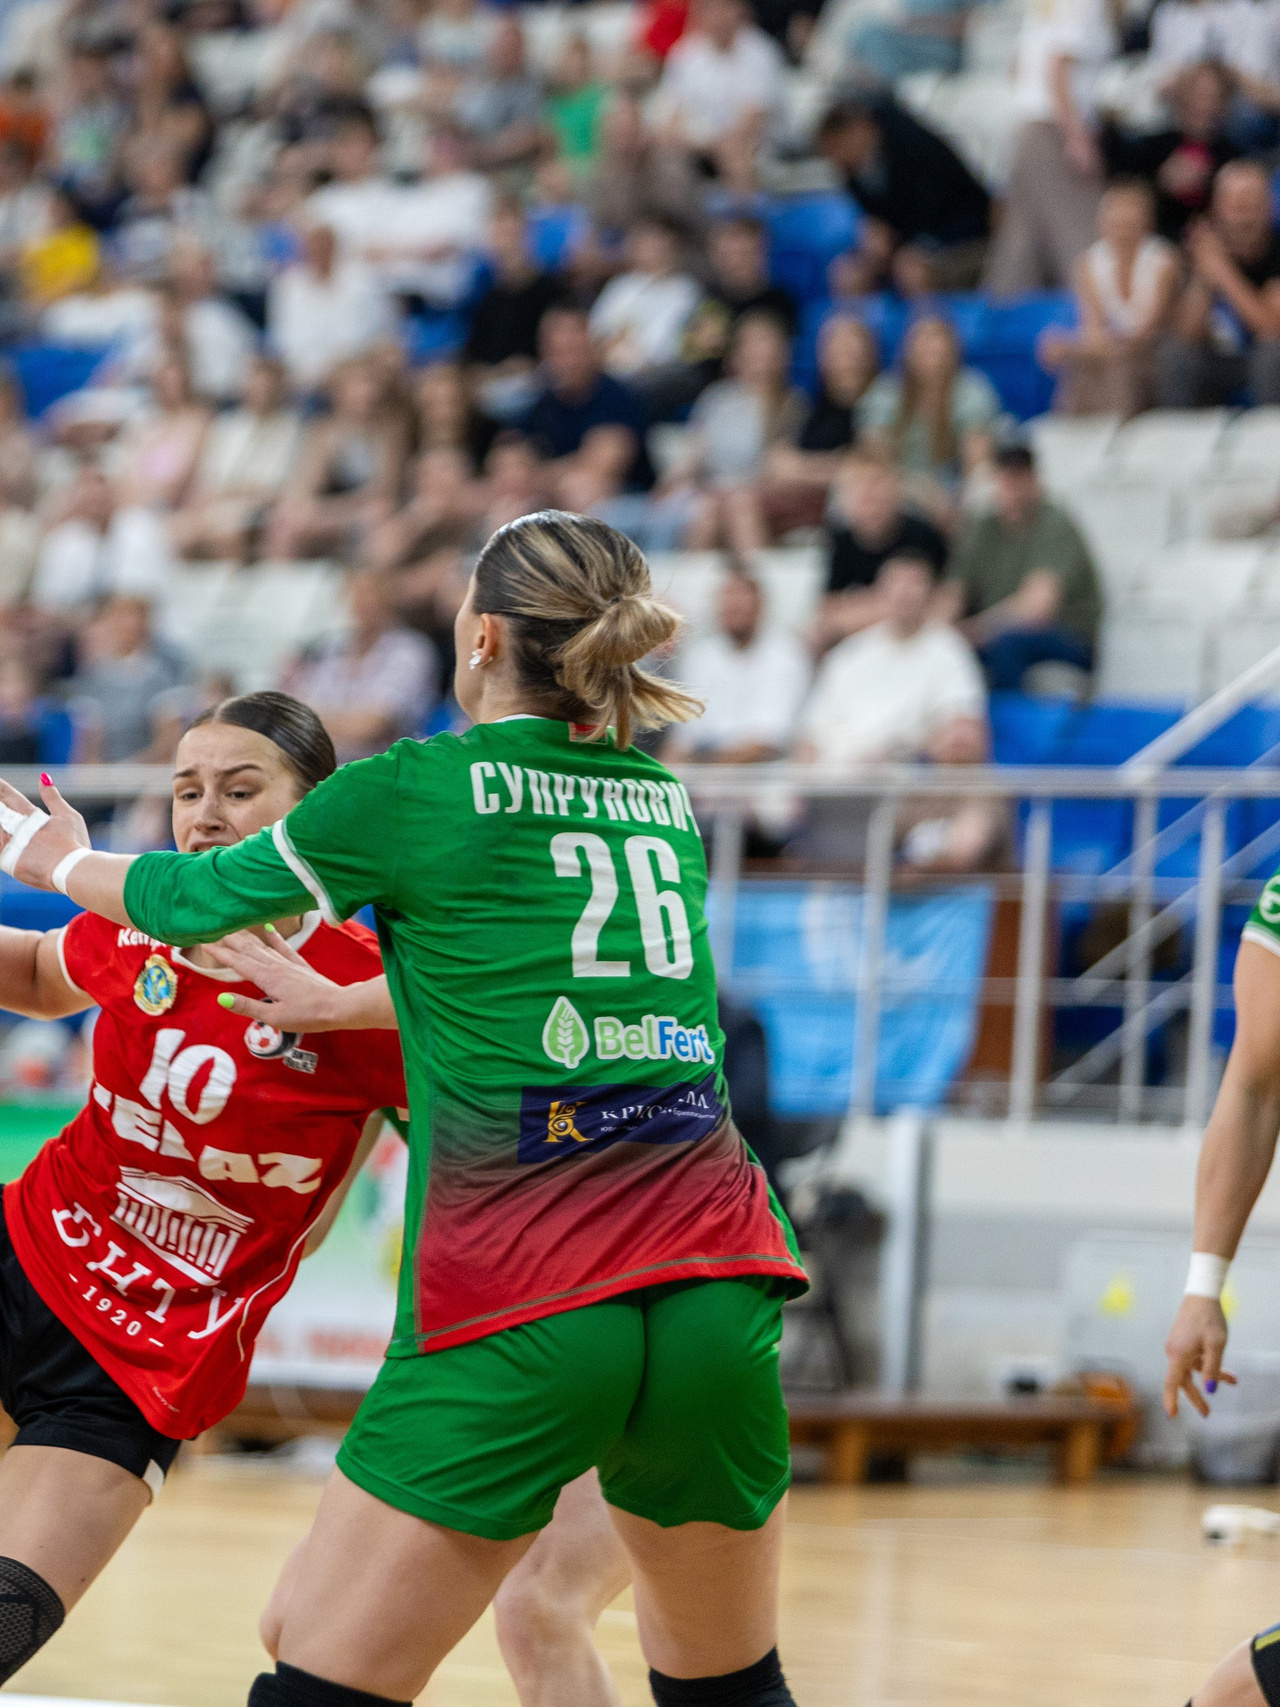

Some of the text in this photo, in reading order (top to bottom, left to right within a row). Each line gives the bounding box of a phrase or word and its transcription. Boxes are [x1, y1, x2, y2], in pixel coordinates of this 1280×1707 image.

[550, 832, 694, 980] 26
[139, 1028, 237, 1125] 10
[594, 1015, 715, 1064] BelFert
